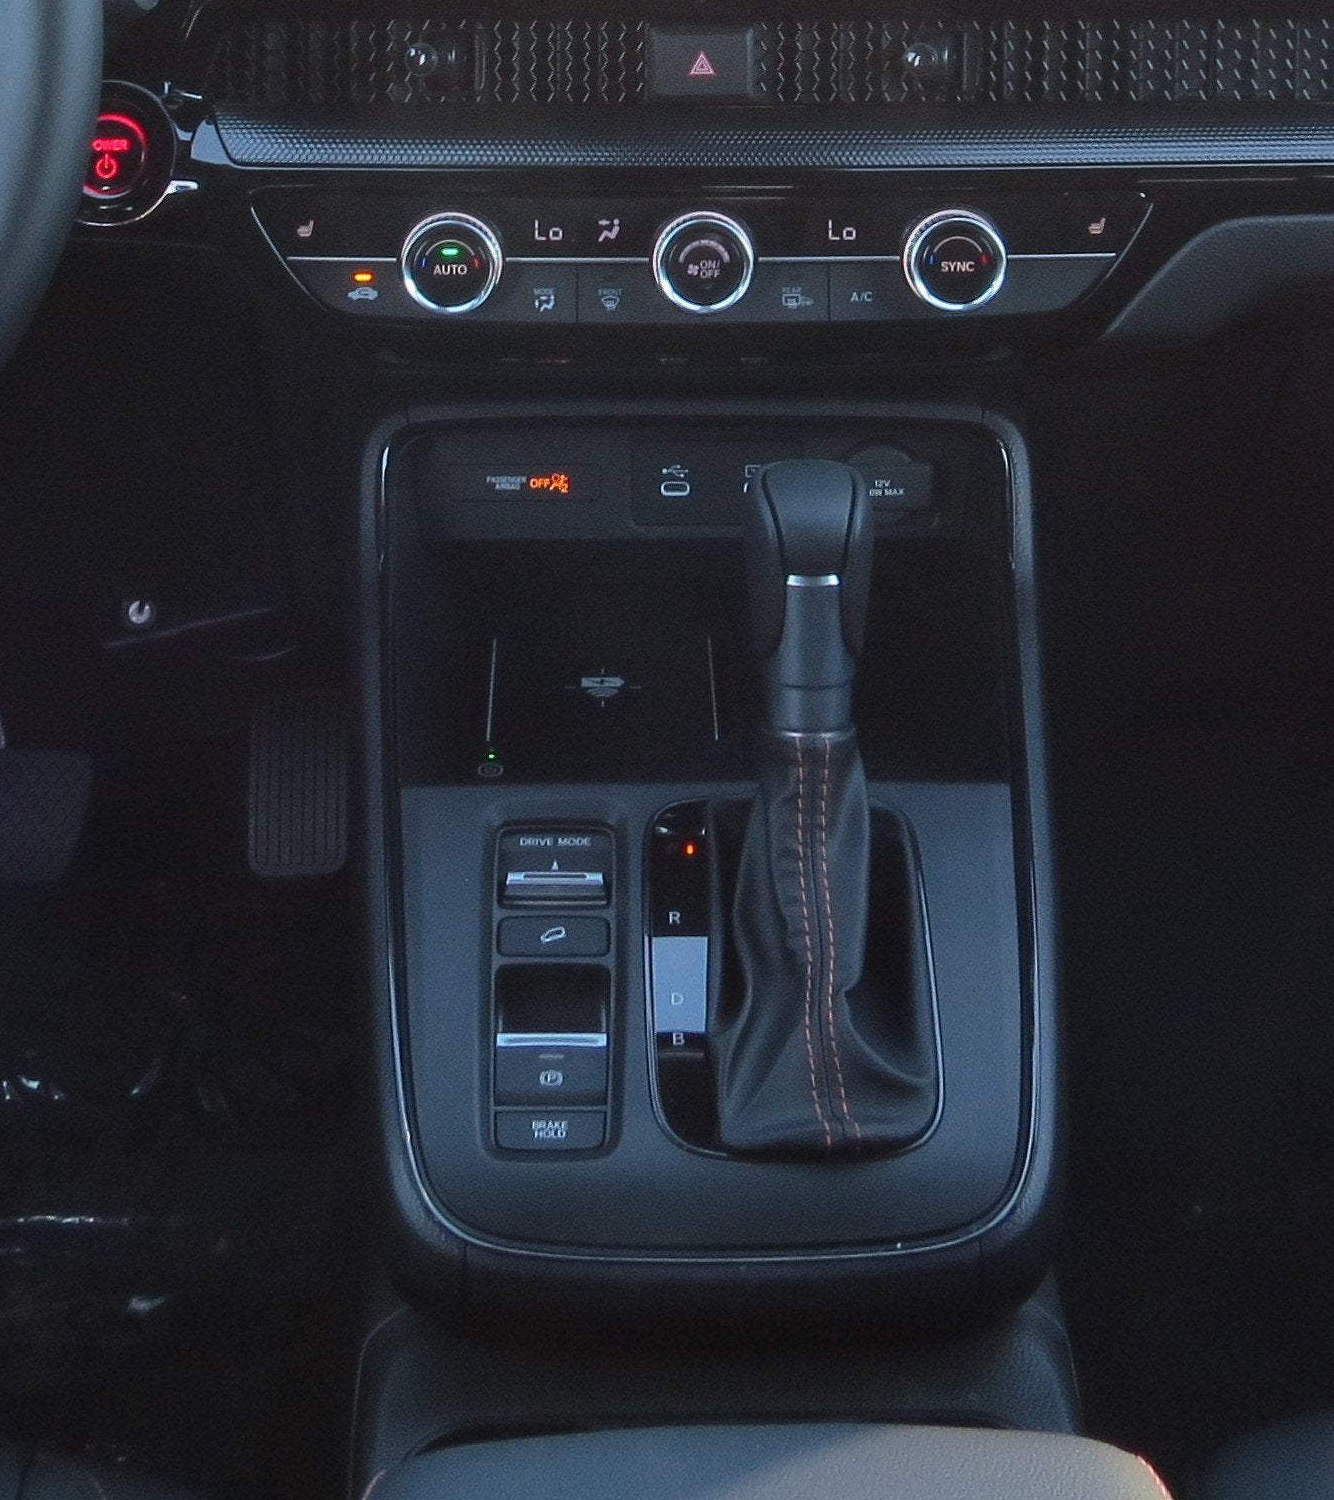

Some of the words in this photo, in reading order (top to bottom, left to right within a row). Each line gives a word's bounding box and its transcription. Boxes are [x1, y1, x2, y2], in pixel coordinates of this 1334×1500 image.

[91, 138, 129, 151] OWER
[534, 219, 563, 241] Lo
[828, 219, 857, 241] Lo
[433, 264, 467, 276] AUTO
[699, 260, 721, 269] ON/
[940, 260, 976, 273] SYNC
[699, 269, 721, 279] OFF
[850, 291, 873, 302] A/C
[529, 478, 551, 489] OFF
[875, 479, 891, 488] 12V
[884, 488, 905, 497] MAX
[519, 836, 554, 847] DRIVE
[558, 836, 592, 847] MODE
[669, 911, 682, 924] R
[670, 992, 684, 1006] D
[672, 1032, 685, 1046] B
[532, 1120, 567, 1131] BRAKE
[534, 1129, 566, 1140] HOLD
